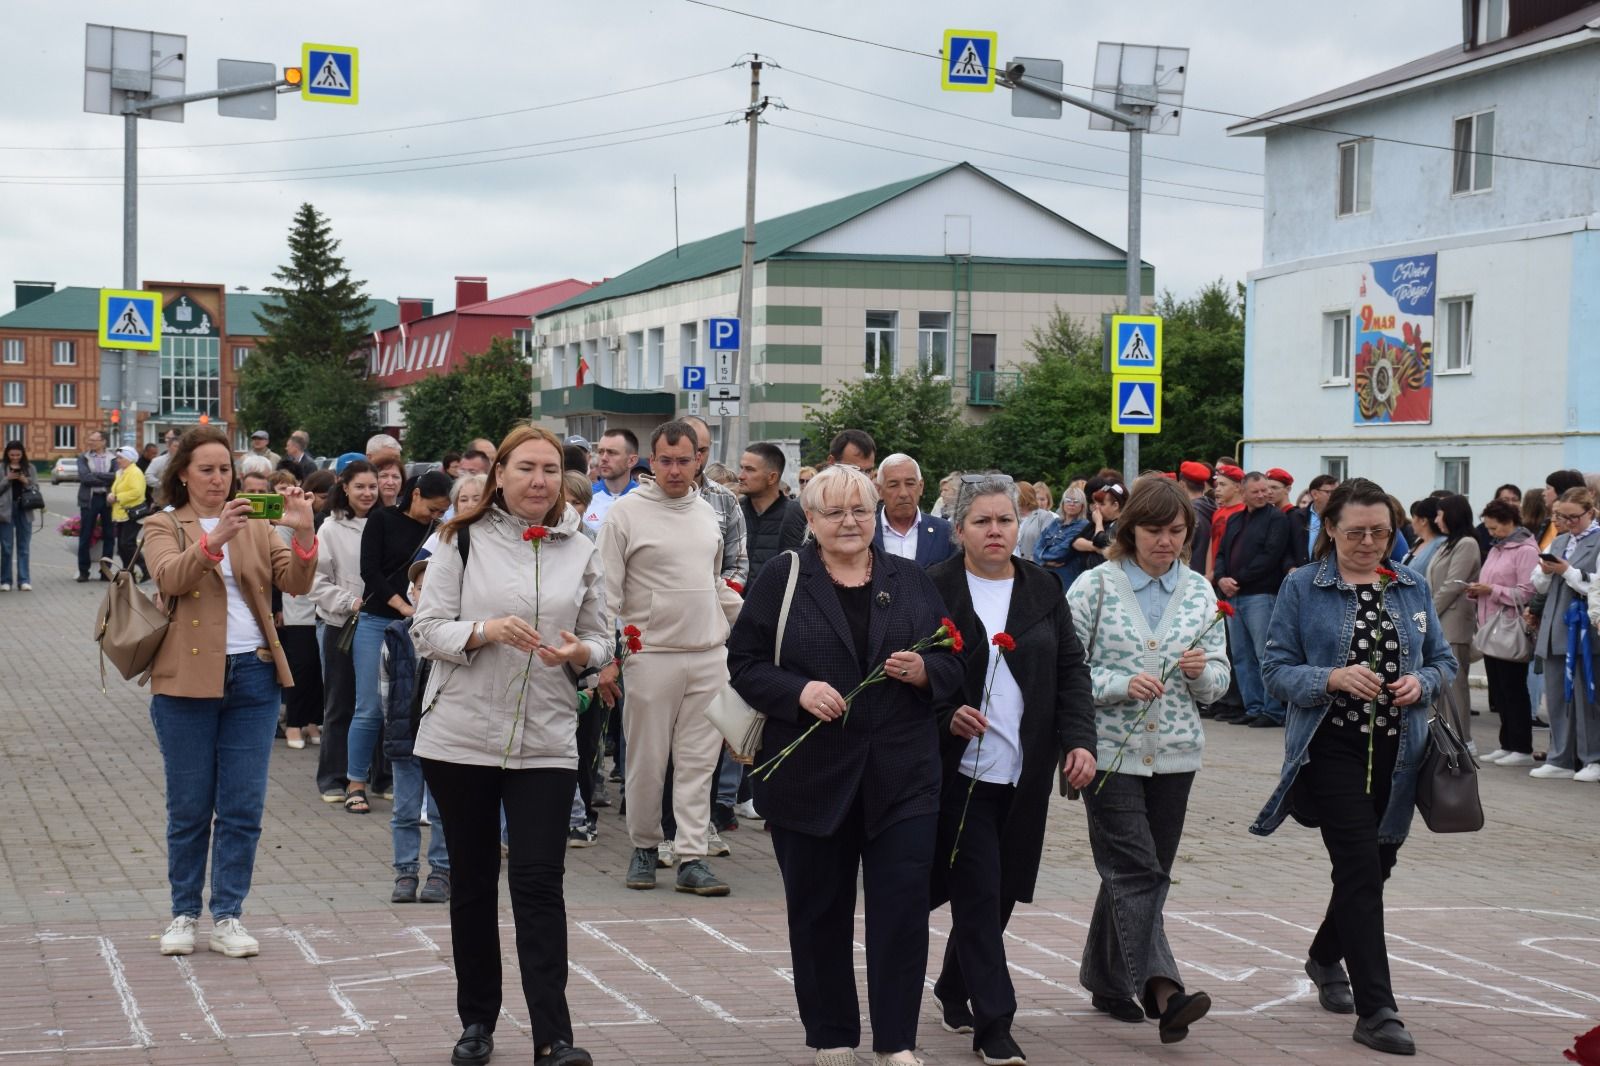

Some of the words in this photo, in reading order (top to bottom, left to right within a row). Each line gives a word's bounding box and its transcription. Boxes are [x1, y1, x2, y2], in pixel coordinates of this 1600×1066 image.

[1360, 303, 1374, 332] 9
[716, 321, 734, 347] P
[688, 368, 702, 388] P
